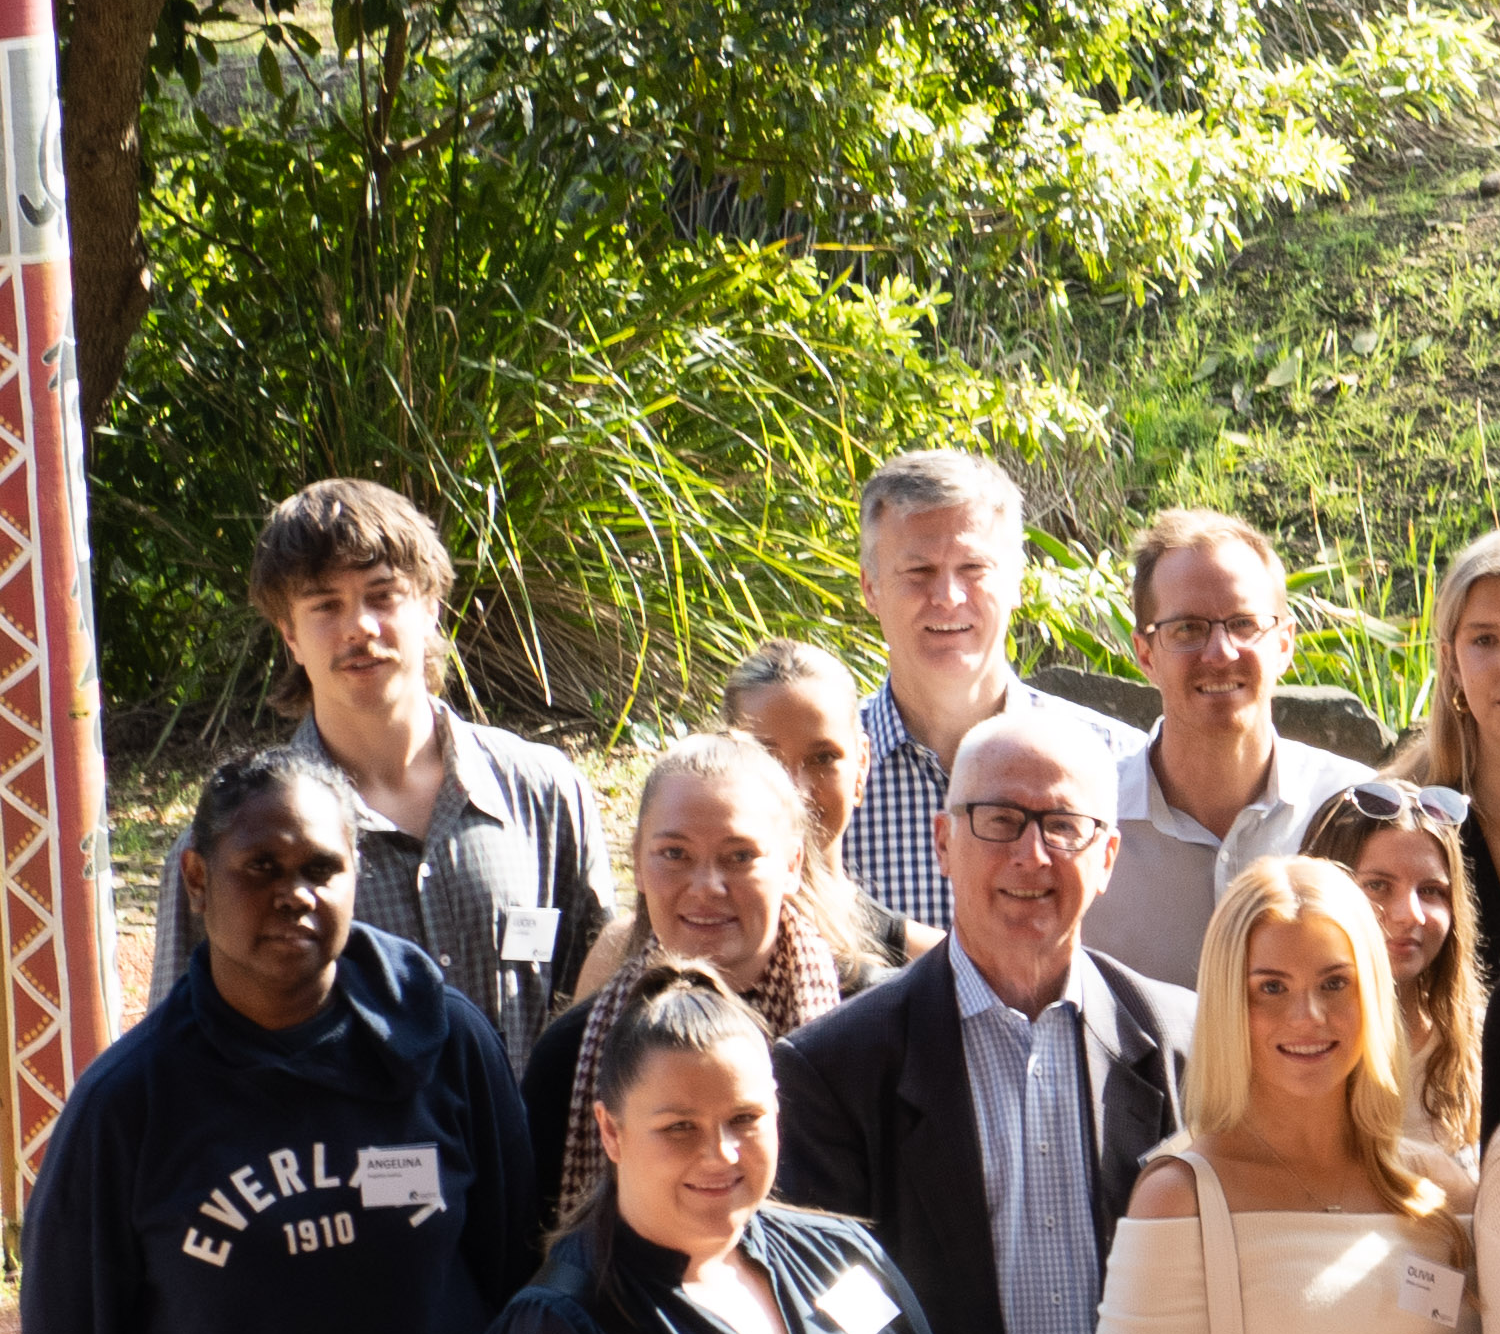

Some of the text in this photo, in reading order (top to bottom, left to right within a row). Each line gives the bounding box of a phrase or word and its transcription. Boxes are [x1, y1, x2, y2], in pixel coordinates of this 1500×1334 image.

[367, 1157, 422, 1170] ANGELINA
[183, 1142, 448, 1267] EVERL
[283, 1211, 356, 1255] 1910
[1407, 1266, 1436, 1283] OLIVIA
